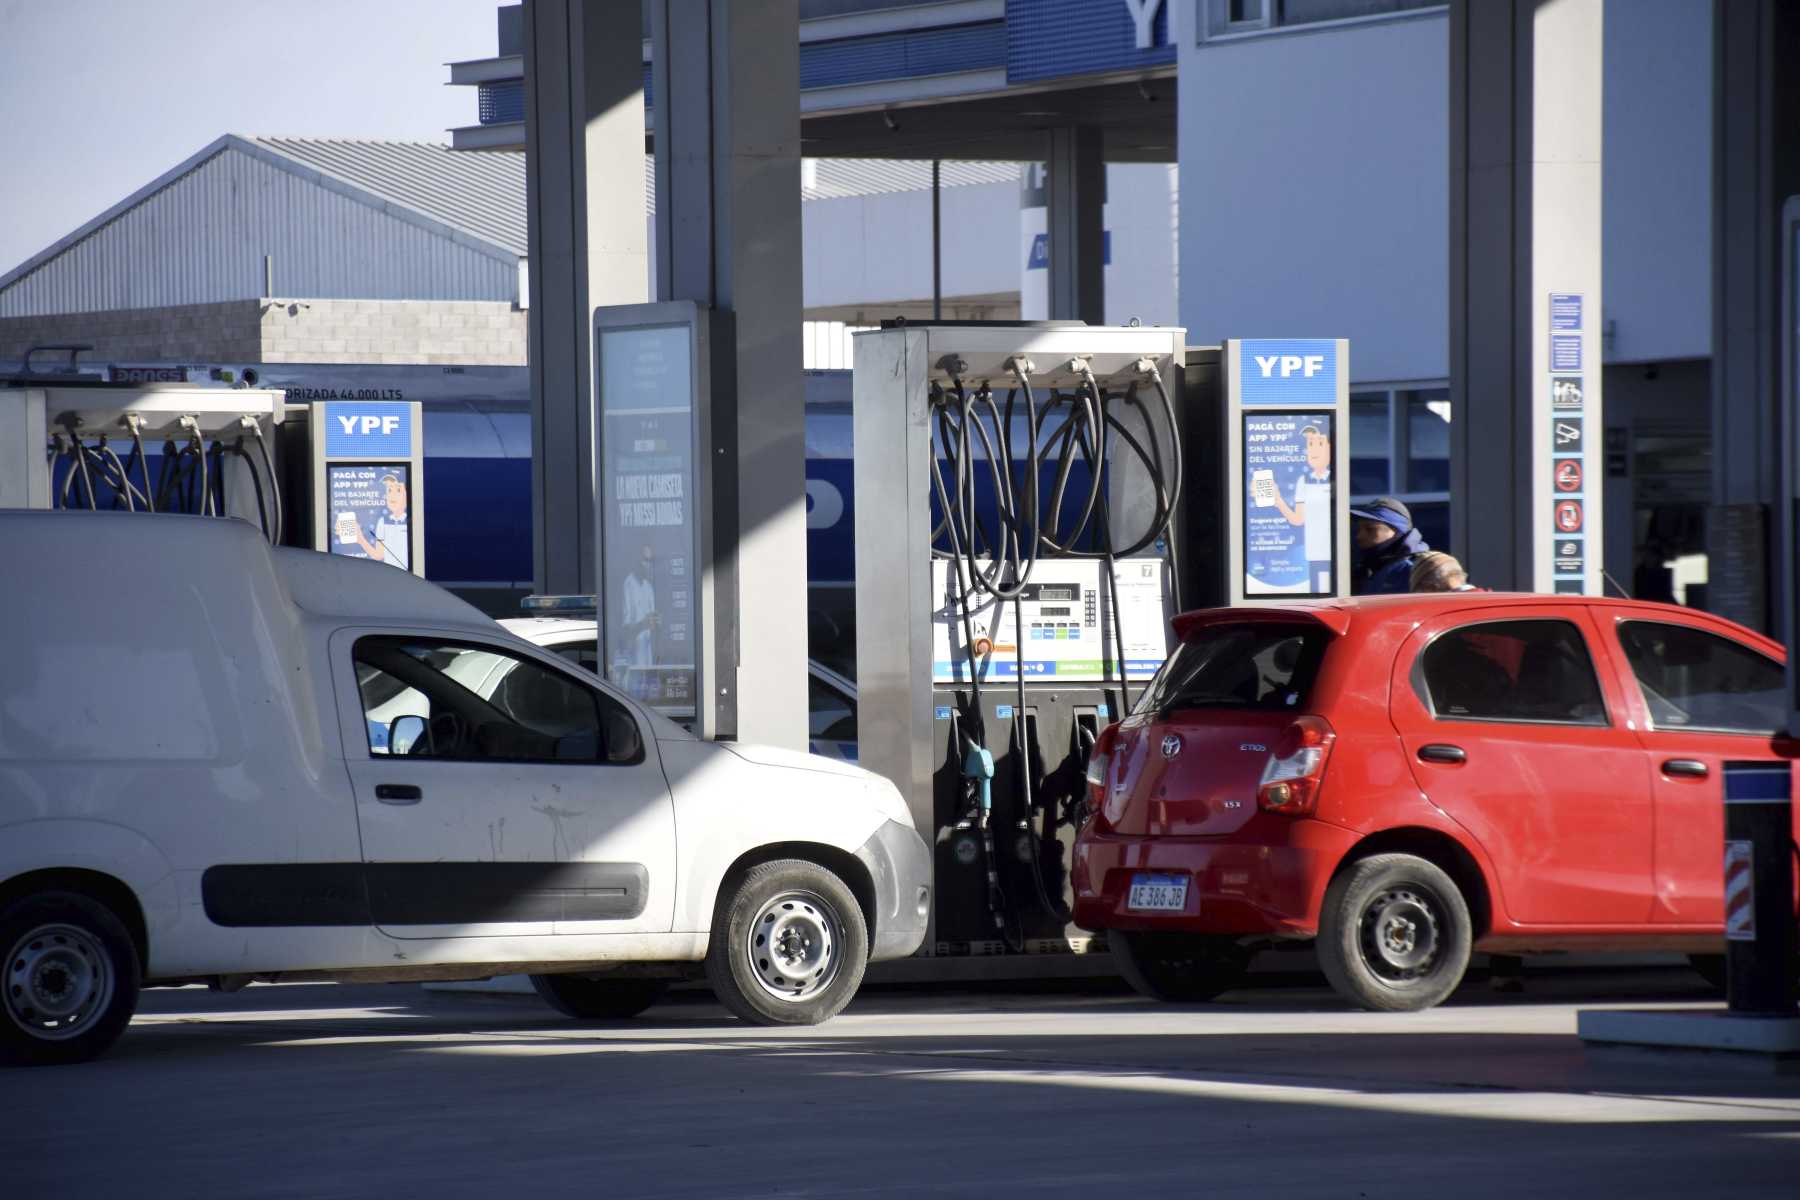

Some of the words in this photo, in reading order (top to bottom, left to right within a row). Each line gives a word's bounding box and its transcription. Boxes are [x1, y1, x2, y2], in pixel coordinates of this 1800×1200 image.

[1254, 355, 1324, 378] YPF
[340, 388, 379, 401] 46.000
[382, 389, 403, 401] LTS
[337, 415, 400, 435] YPF
[1131, 887, 1146, 907] AE
[1147, 887, 1167, 907] 386
[1168, 887, 1184, 908] JB
